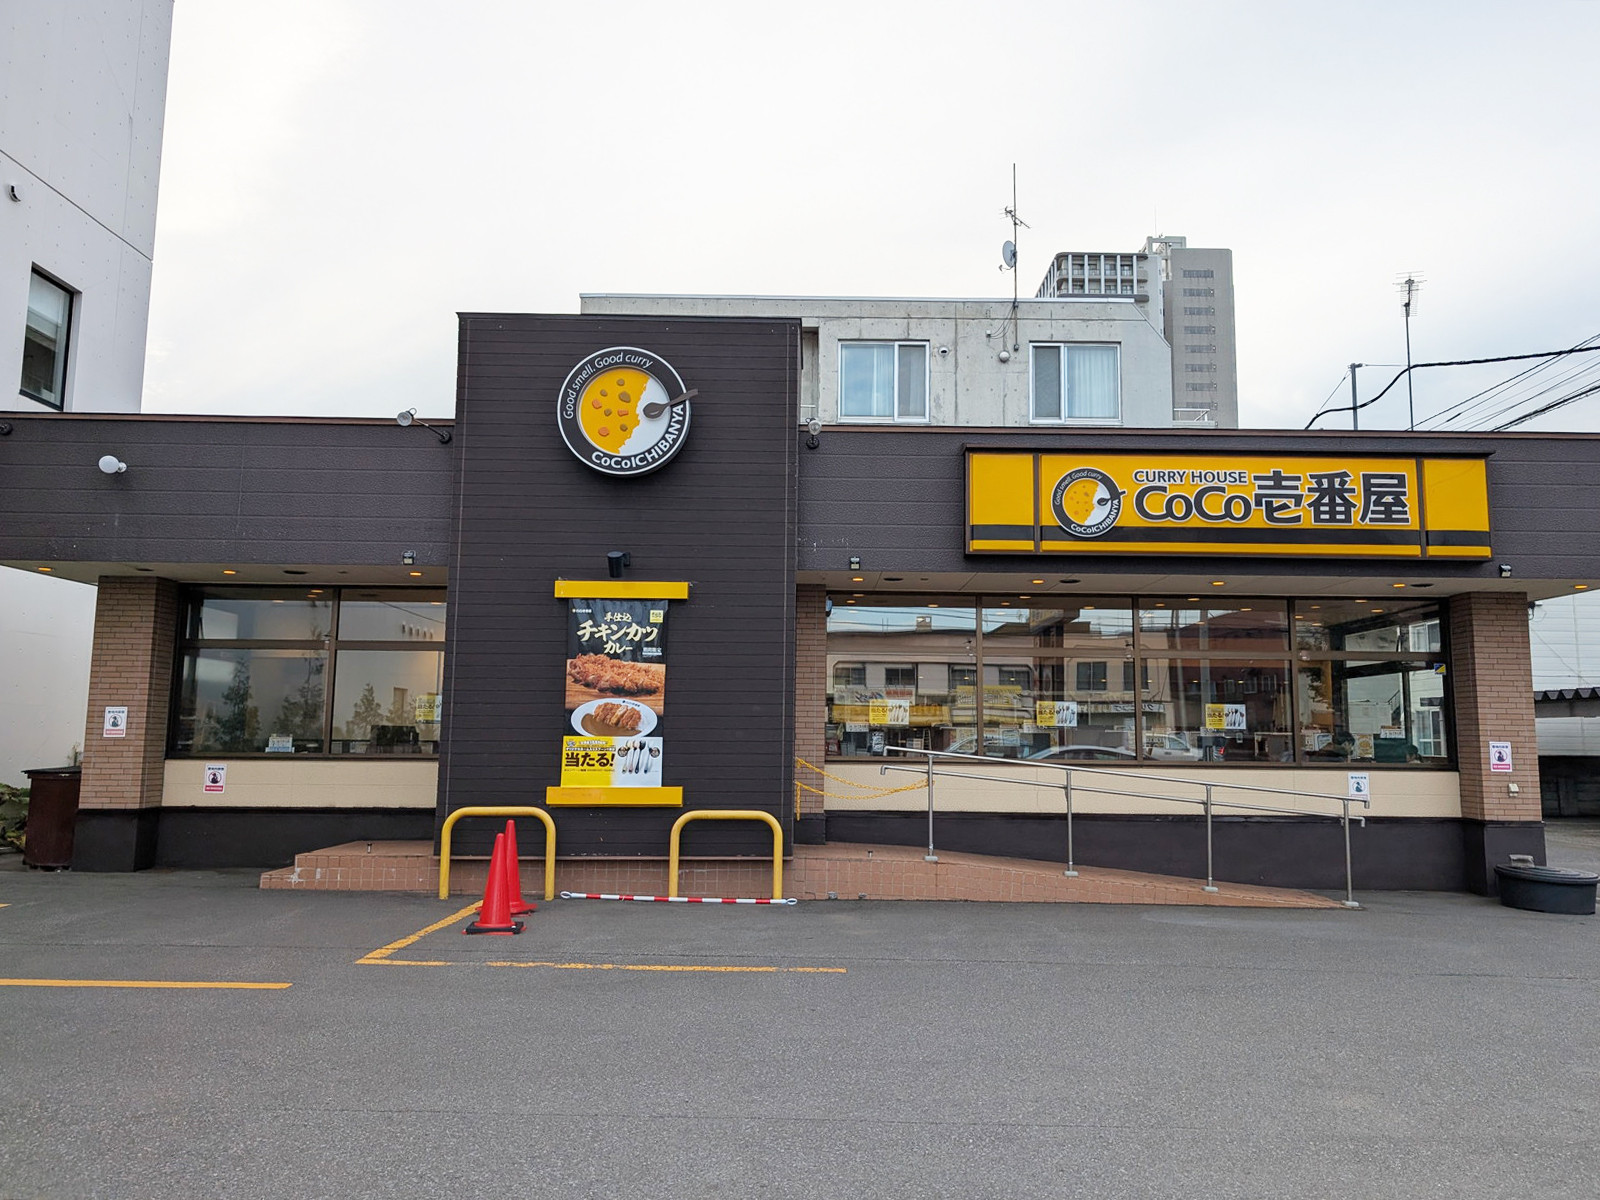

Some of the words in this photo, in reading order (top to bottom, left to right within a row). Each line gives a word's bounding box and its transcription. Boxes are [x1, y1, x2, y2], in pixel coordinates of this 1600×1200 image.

[563, 389, 577, 420] Good
[572, 364, 597, 390] smell.
[595, 352, 623, 369] Good
[625, 354, 653, 369] curry
[591, 404, 685, 469] CoCoICHIBANYA
[1072, 471, 1087, 479] Good
[1133, 470, 1187, 484] CURRY
[1190, 470, 1248, 484] HOUSE
[1071, 500, 1119, 533] CoCoICHIBANYA
[604, 612, 632, 623] 手仕込
[576, 619, 659, 642] チキンカツ
[603, 641, 633, 654] カレー
[564, 752, 616, 767] 当たる!
